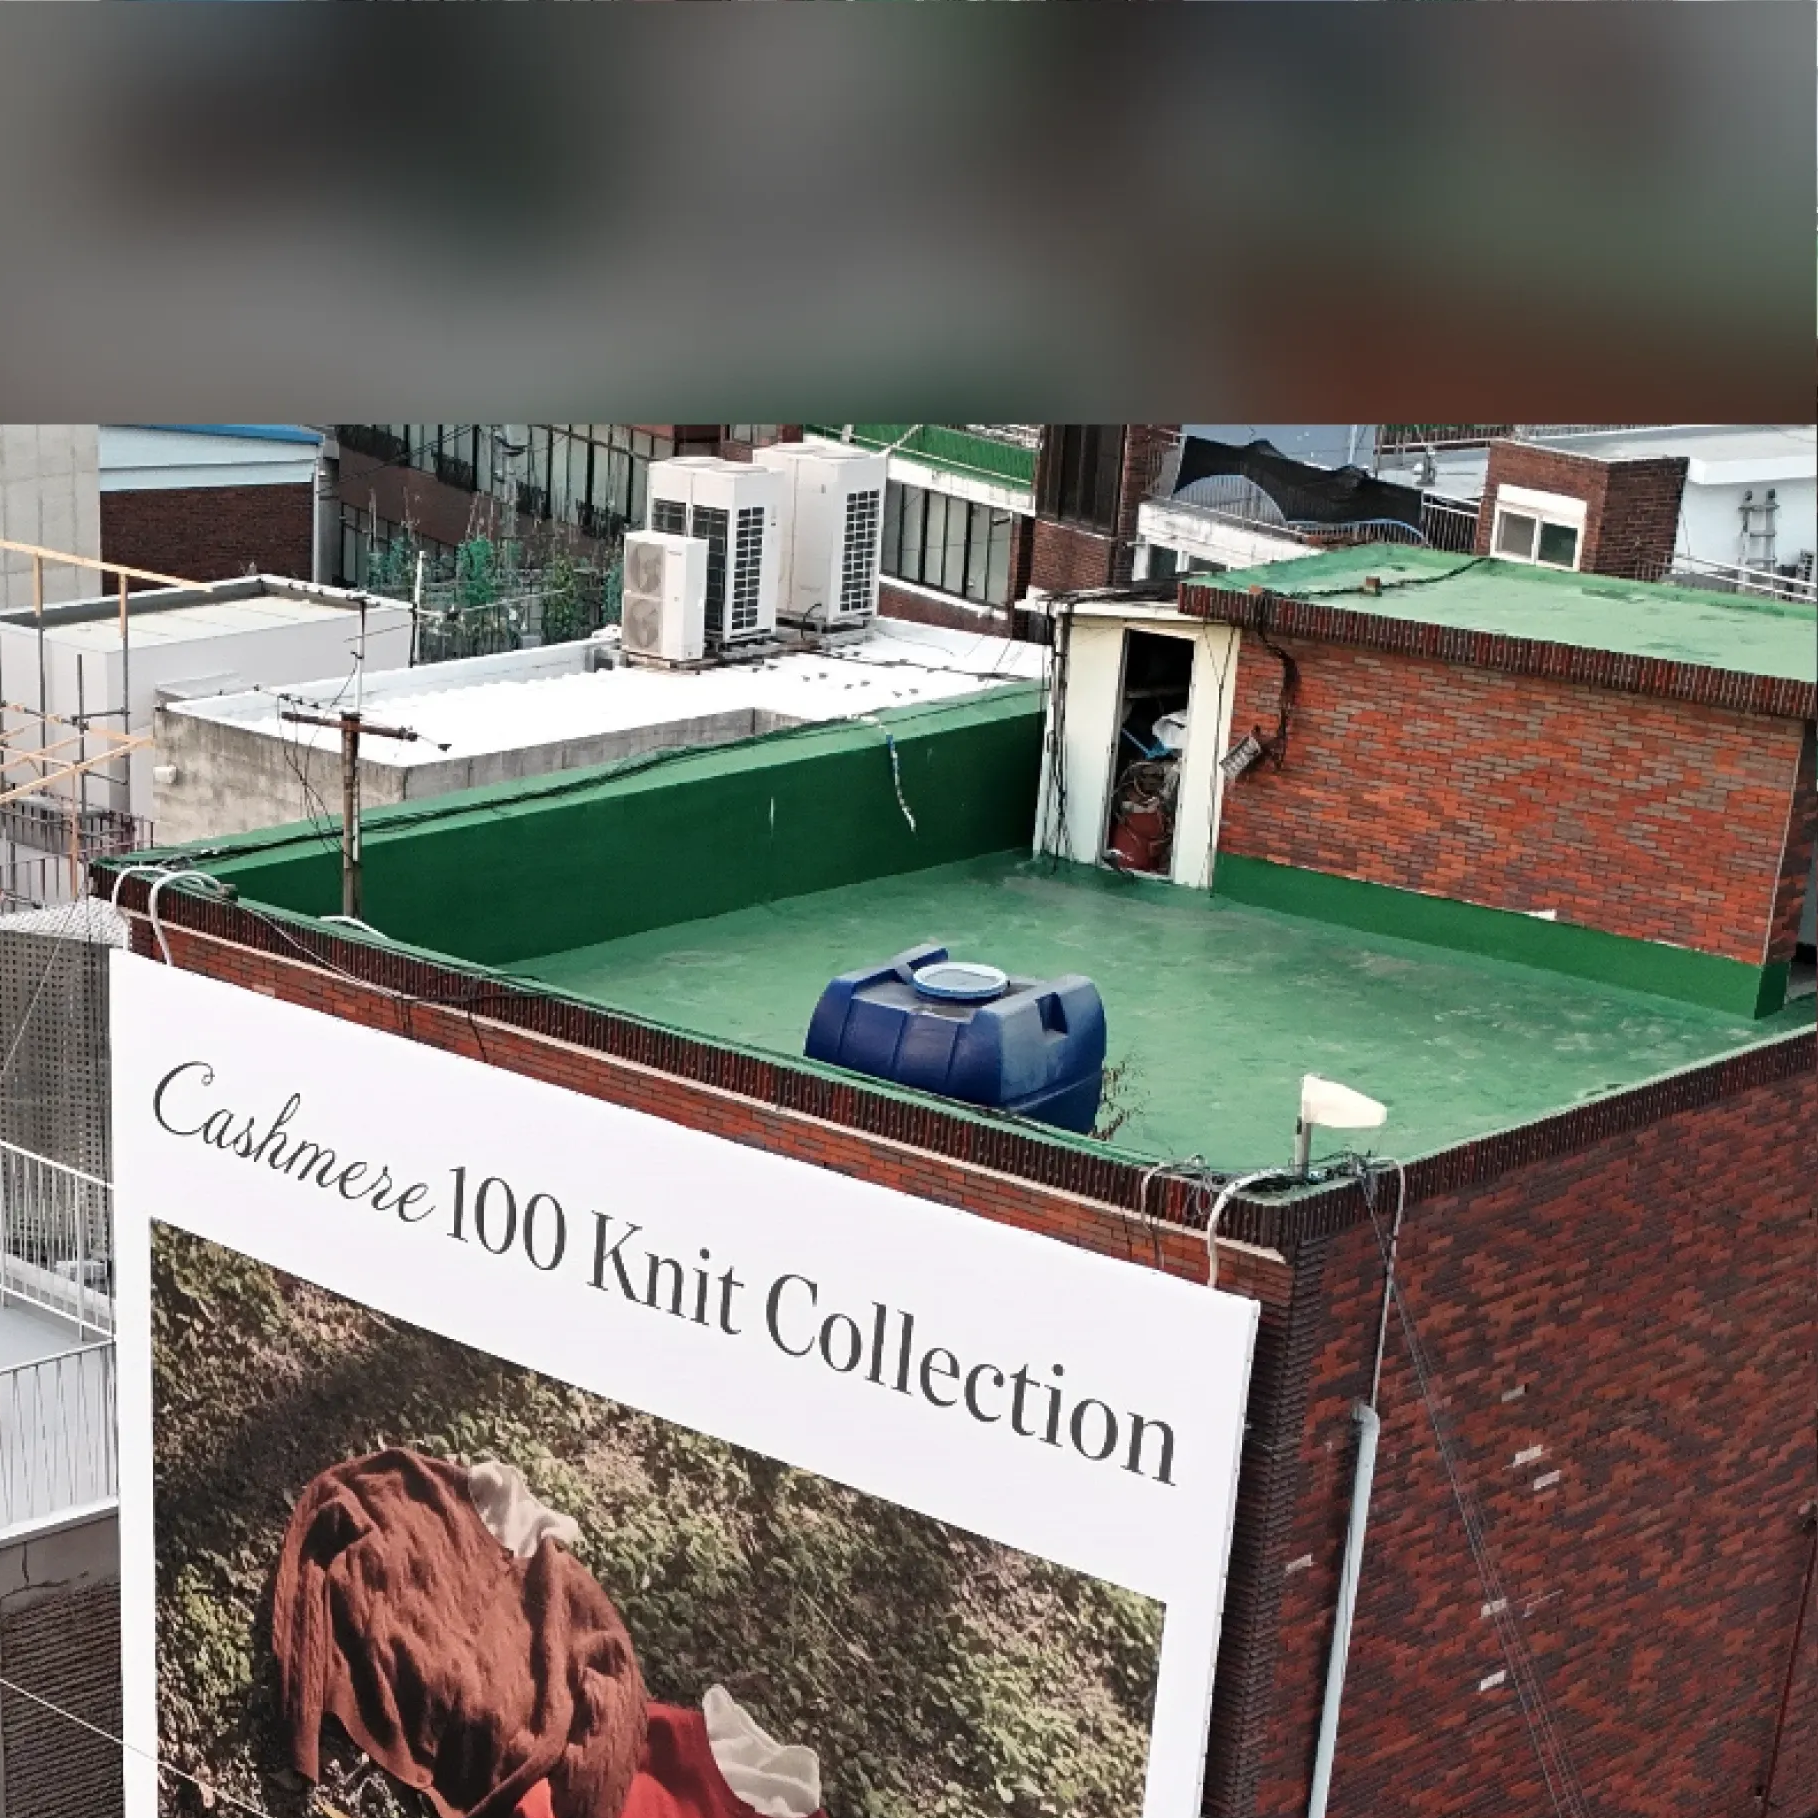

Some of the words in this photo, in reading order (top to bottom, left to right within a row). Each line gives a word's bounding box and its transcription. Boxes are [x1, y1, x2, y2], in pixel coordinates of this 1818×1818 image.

[151, 1060, 436, 1224] Cashmere
[446, 1165, 569, 1273] 100
[587, 1209, 746, 1338] Knit
[763, 1273, 1179, 1488] Collection
